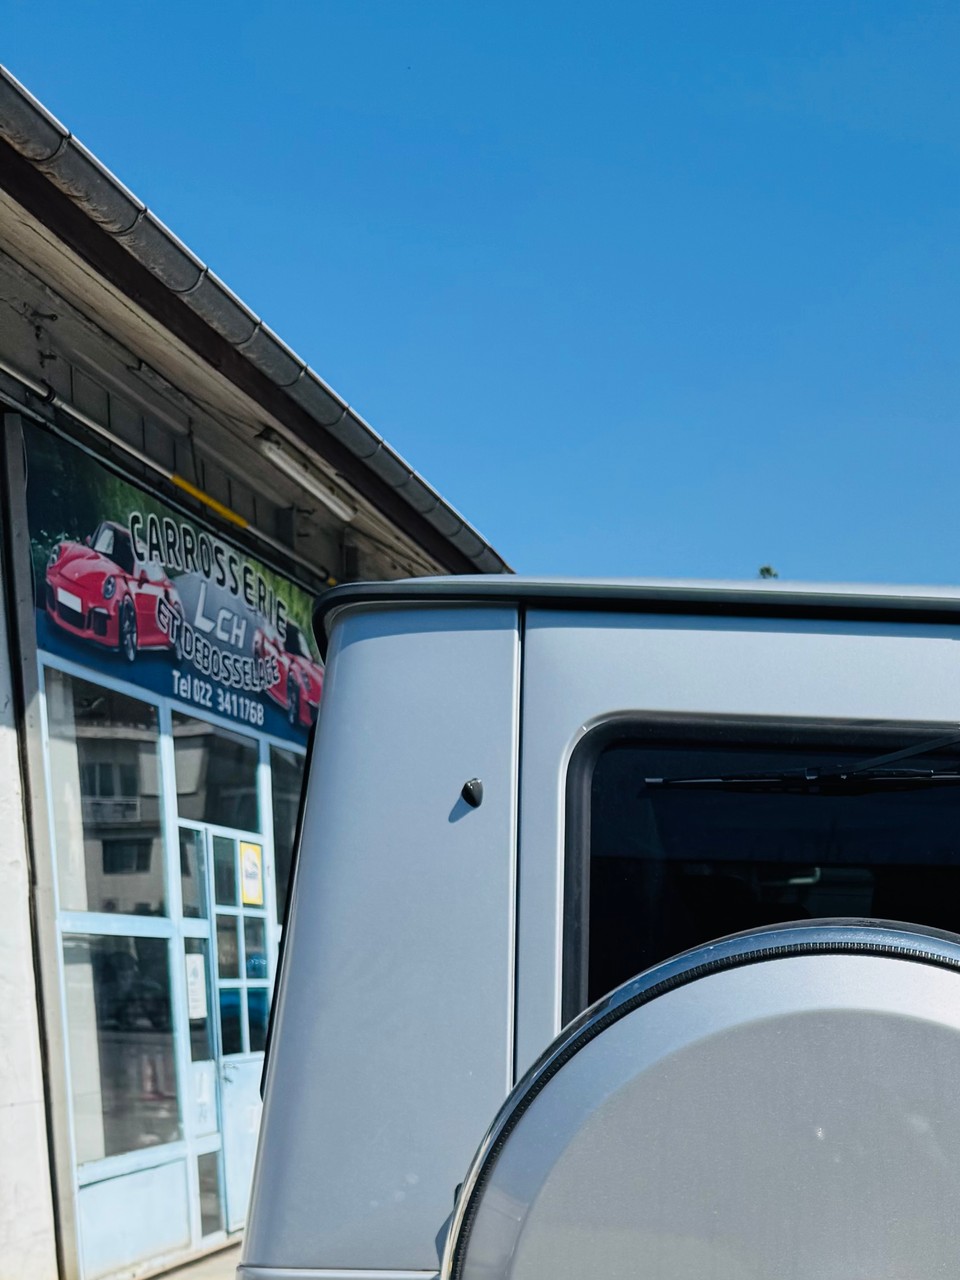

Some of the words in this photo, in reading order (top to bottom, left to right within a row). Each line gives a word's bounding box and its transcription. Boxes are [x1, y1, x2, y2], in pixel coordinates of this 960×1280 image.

[129, 511, 287, 643] CARROSSERIE
[194, 581, 247, 648] LCH
[156, 594, 181, 643] ET
[181, 621, 281, 693] DEBOSSELAGE
[172, 670, 192, 699] Tel
[193, 678, 213, 707] 022
